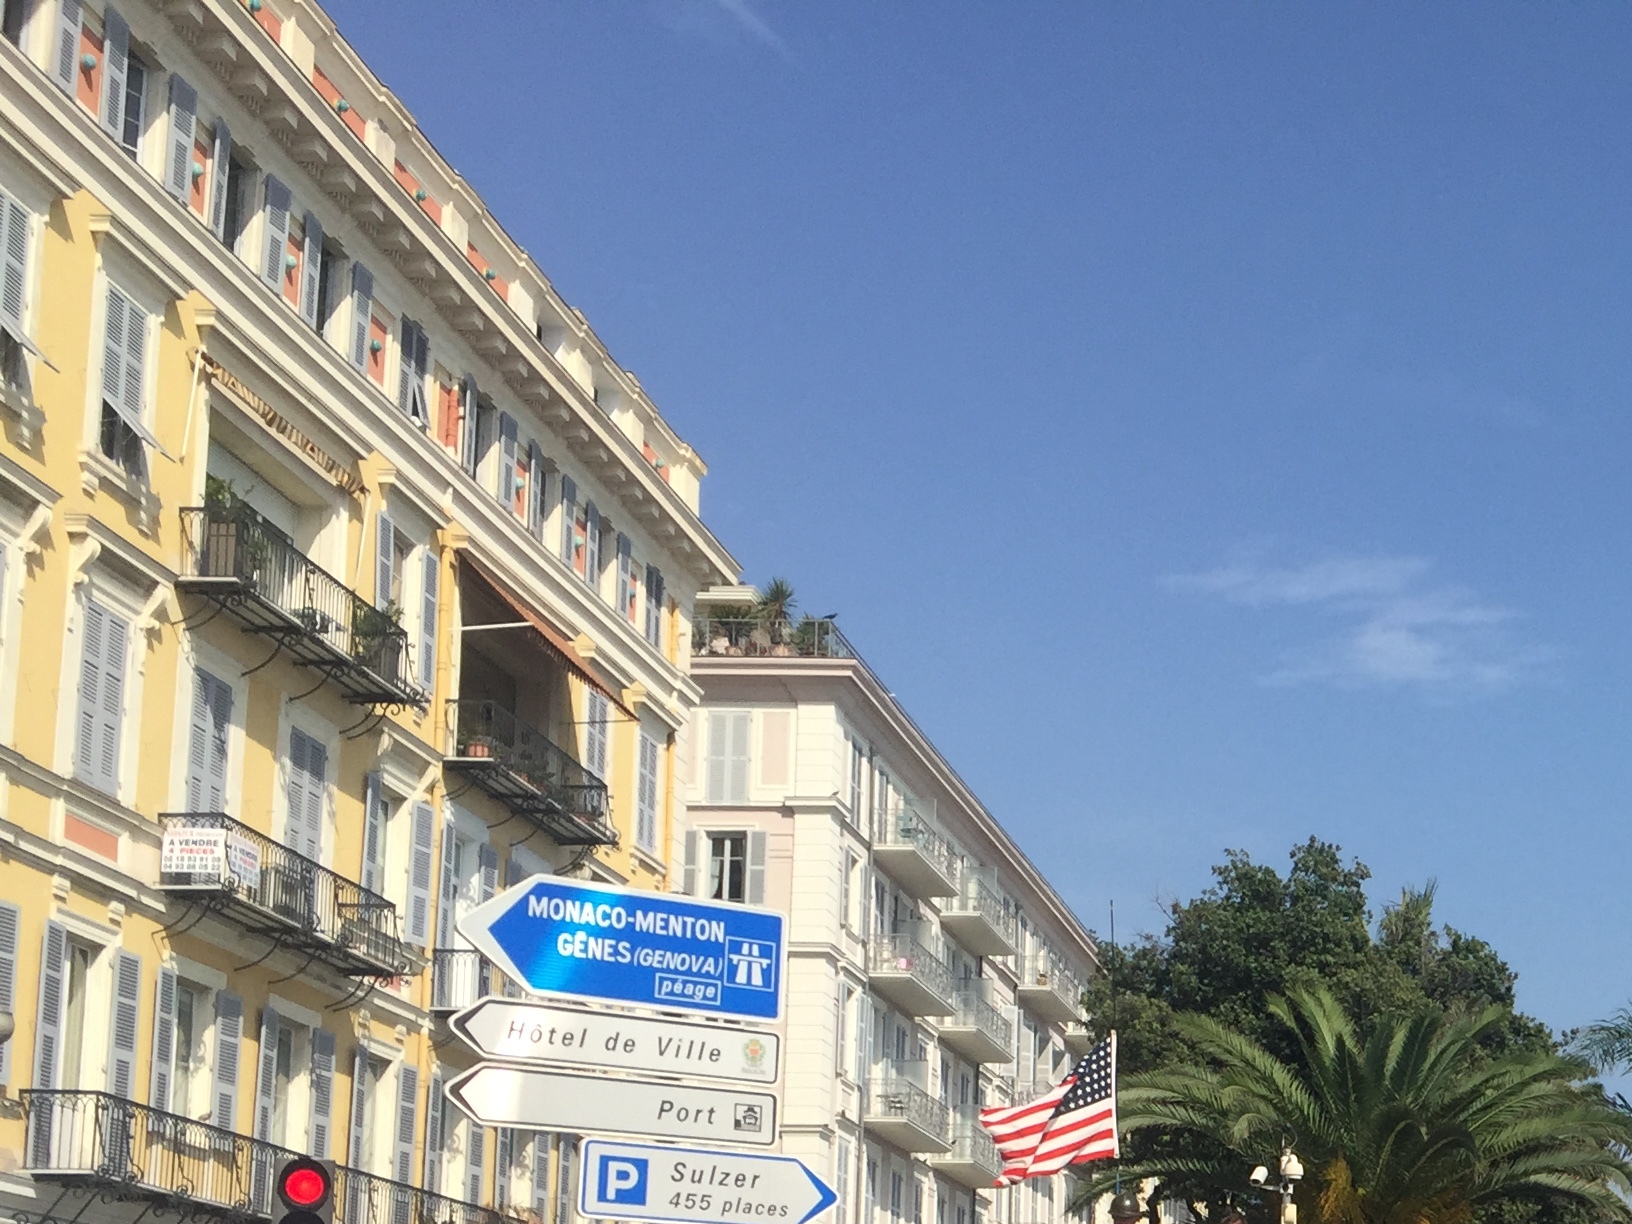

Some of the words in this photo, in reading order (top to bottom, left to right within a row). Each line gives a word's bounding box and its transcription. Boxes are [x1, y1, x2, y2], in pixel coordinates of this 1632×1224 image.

[178, 839, 219, 847] VENDRE
[528, 895, 725, 943] MONACO-MENTON
[557, 931, 631, 963] GÊNES
[632, 944, 723, 977] (GENOVA)
[660, 977, 716, 1001] péage
[507, 1020, 586, 1049] Hôtel
[605, 1032, 636, 1054] de
[657, 1036, 722, 1063] Ville
[657, 1099, 717, 1125] Port
[670, 1162, 761, 1190] Sulzer
[669, 1193, 712, 1212] 455
[721, 1196, 789, 1218] places
